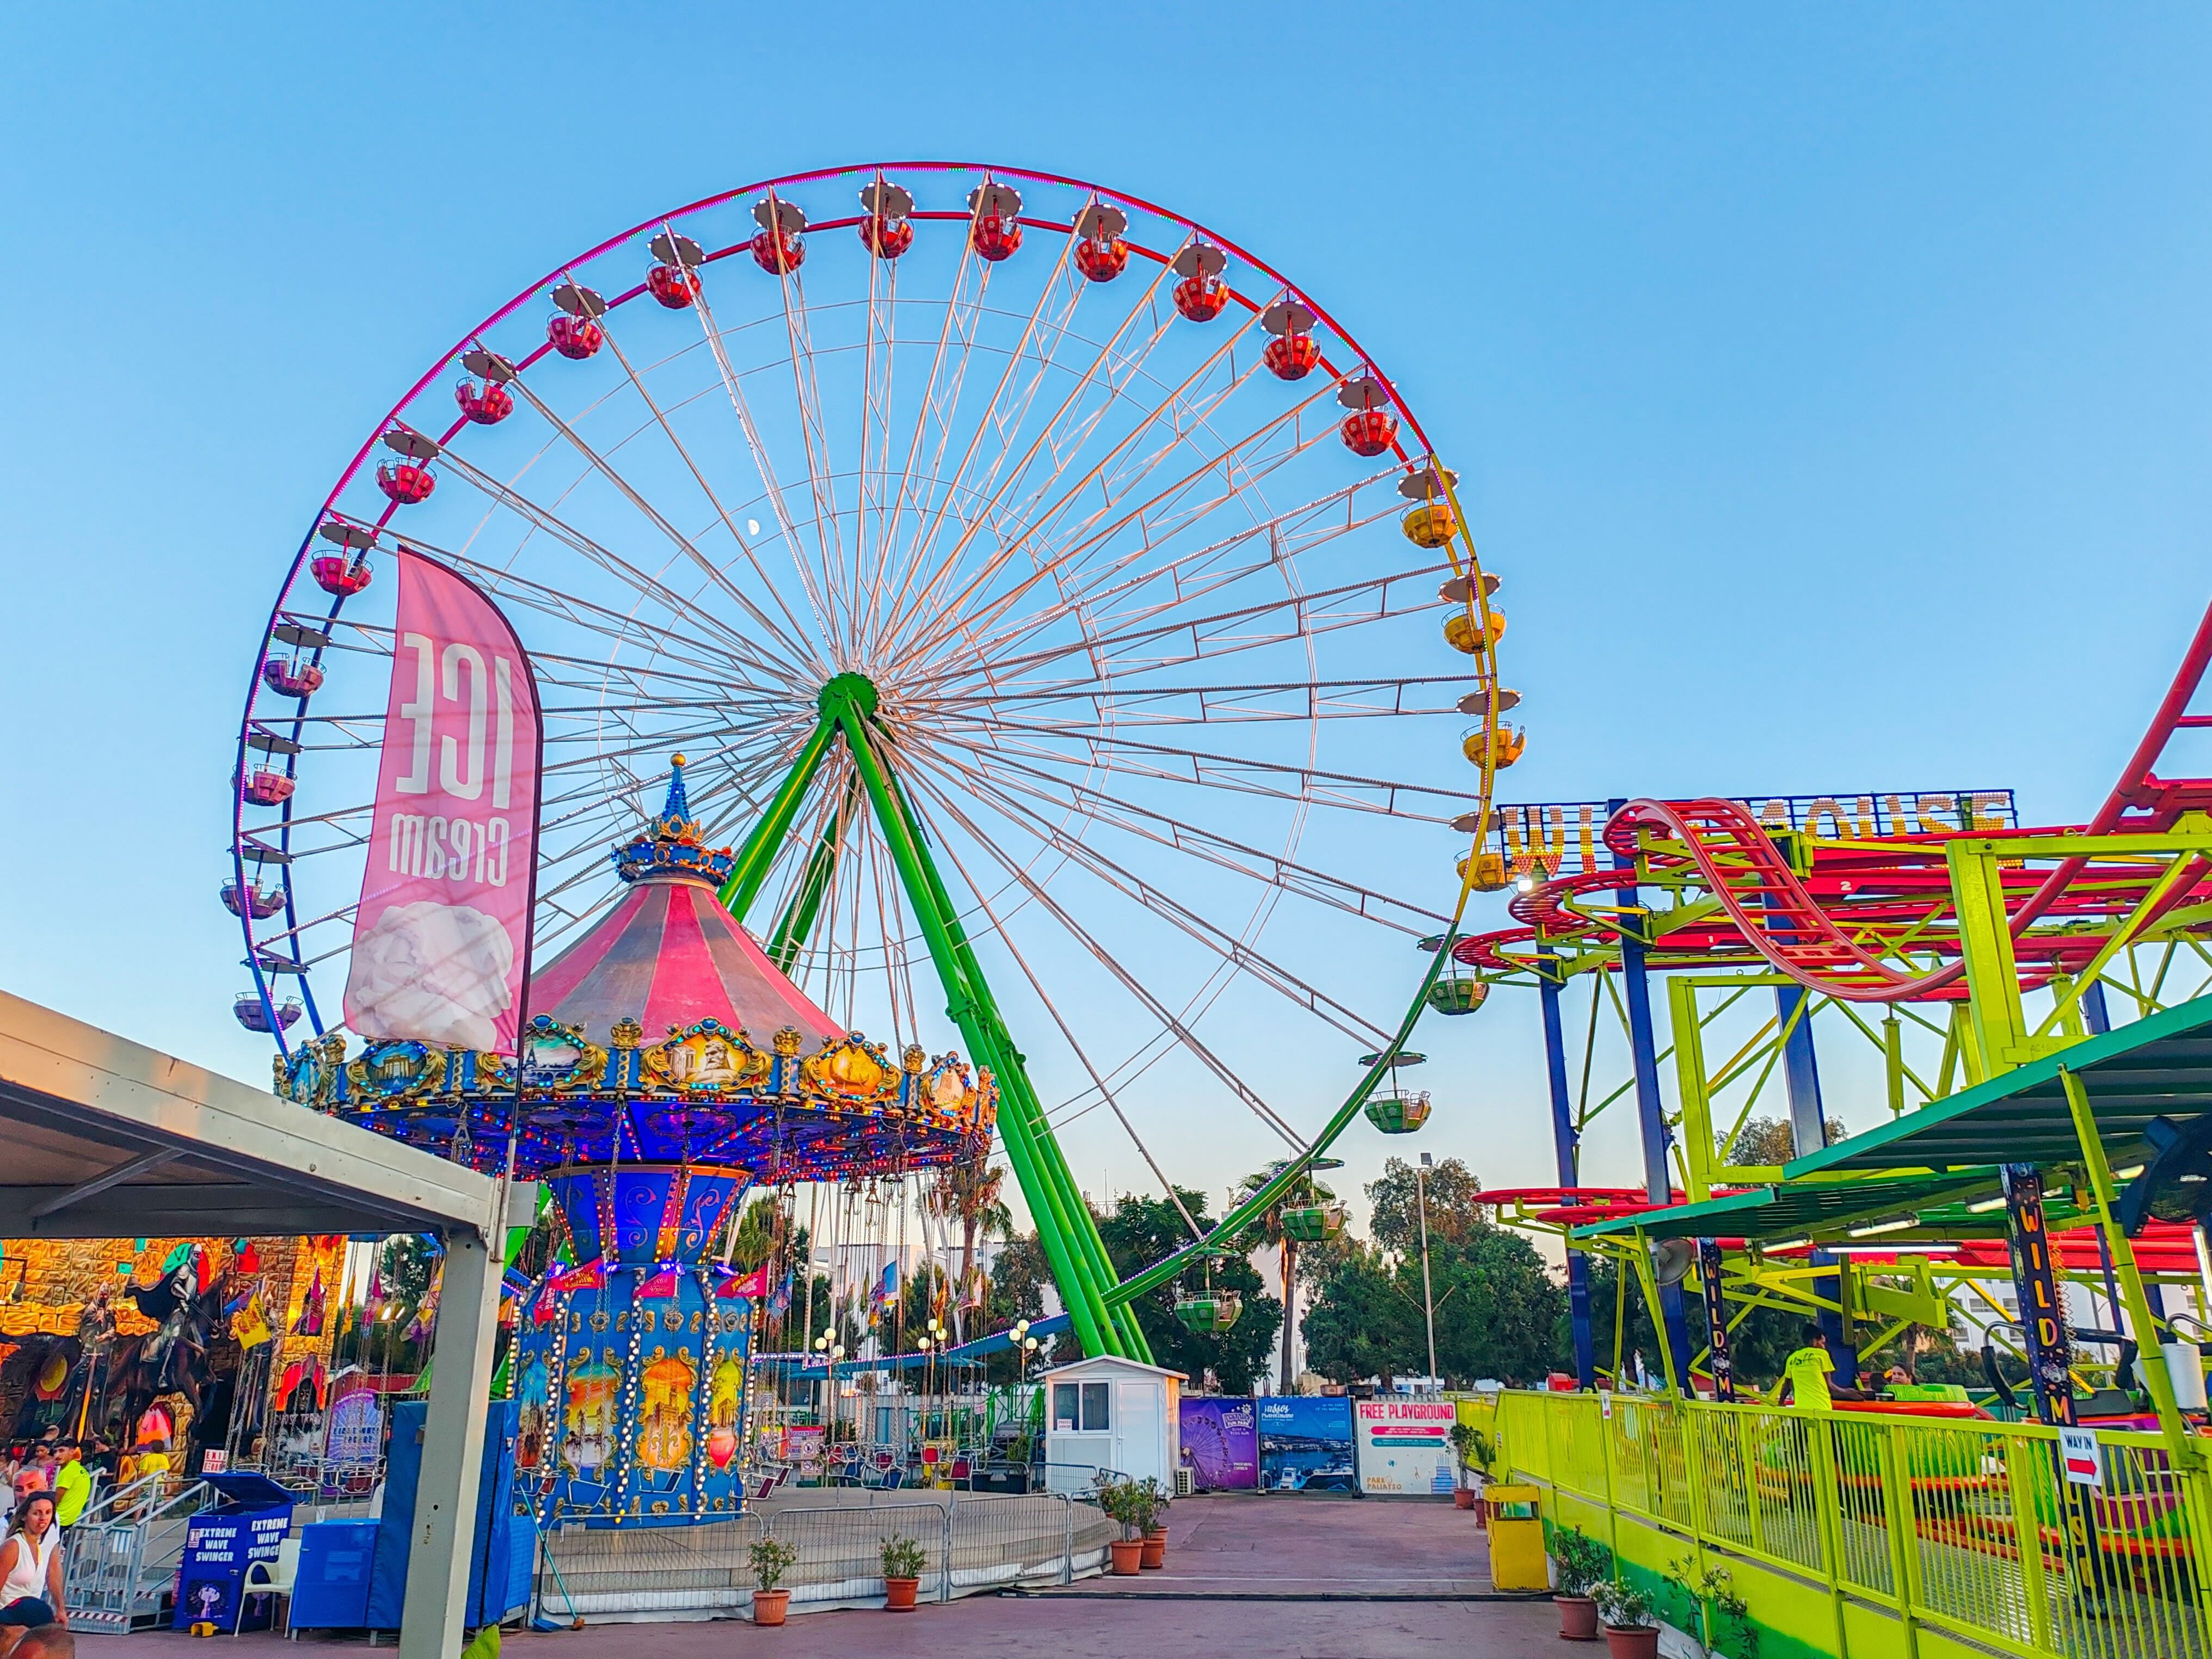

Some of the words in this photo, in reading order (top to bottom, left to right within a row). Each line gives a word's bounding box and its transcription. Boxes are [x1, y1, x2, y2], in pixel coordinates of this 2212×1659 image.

[1840, 881, 1852, 891] 2
[2020, 1206, 2058, 1347] WILD
[1705, 1263, 1724, 1348] WILD
[1360, 1404, 1384, 1419] FREE
[1388, 1404, 1454, 1420] PLAYGROUND
[2064, 1434, 2082, 1449] WAY
[2082, 1436, 2092, 1450] IN
[251, 1517, 288, 1532] EXTREME
[199, 1527, 237, 1538] EXTREME
[257, 1532, 280, 1545] WAVE
[205, 1540, 229, 1550] WAVE
[247, 1545, 280, 1559] SWINGE
[195, 1552, 234, 1562] SWINGER
